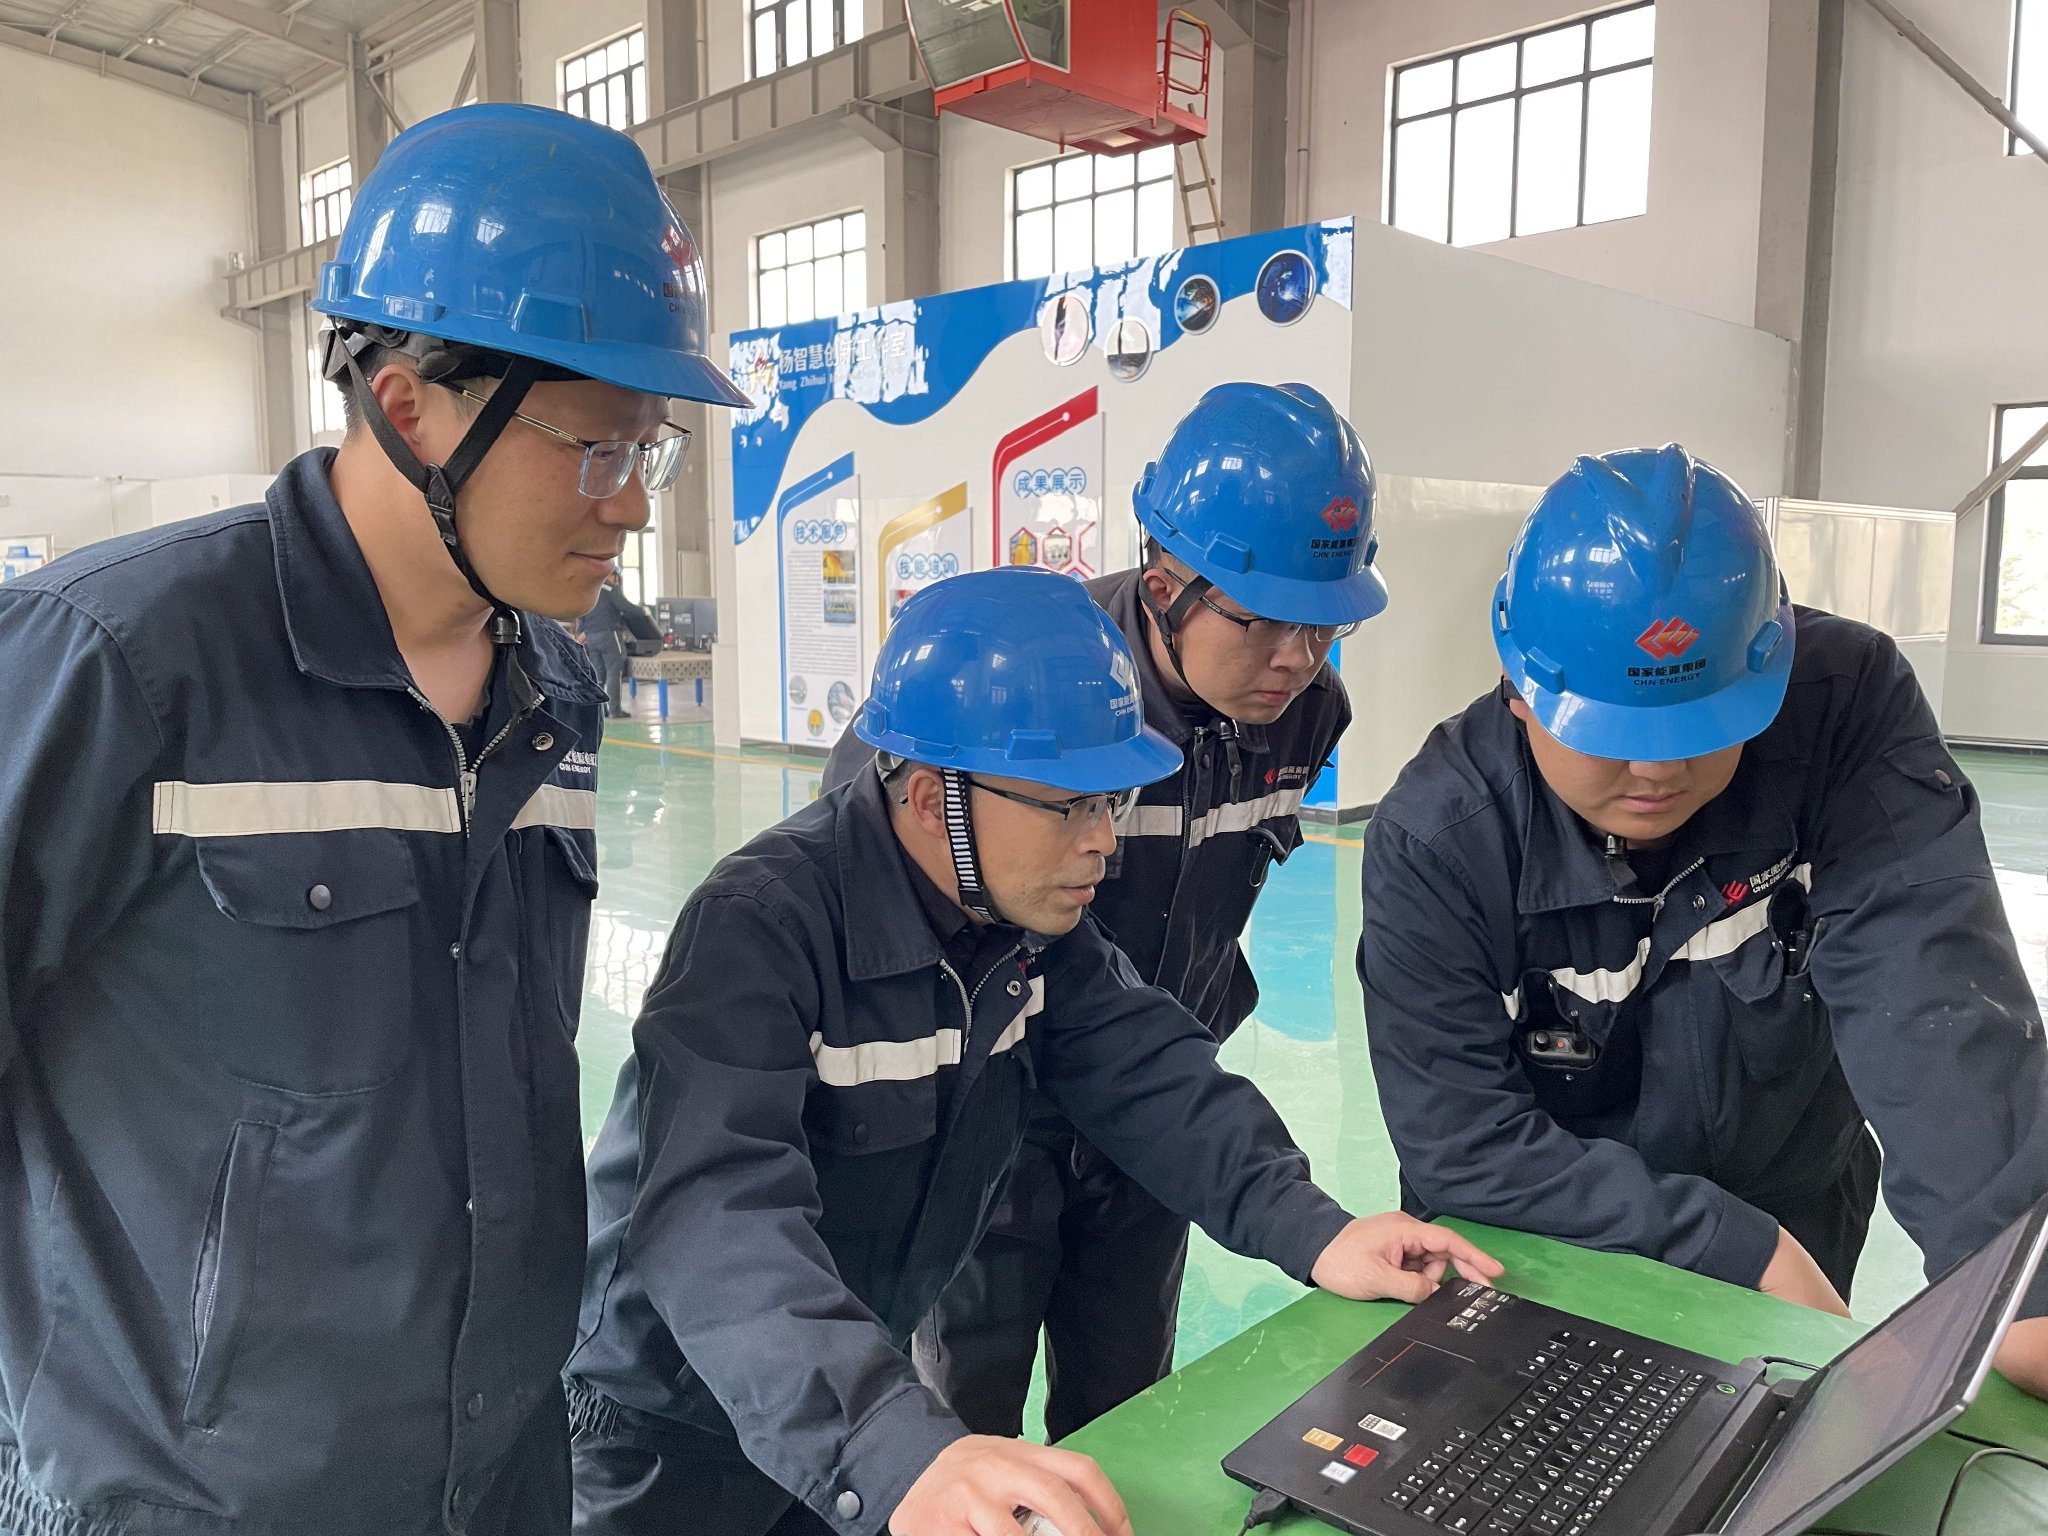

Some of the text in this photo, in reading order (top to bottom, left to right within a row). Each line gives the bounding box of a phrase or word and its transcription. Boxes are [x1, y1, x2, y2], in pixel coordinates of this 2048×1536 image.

[1017, 472, 1084, 494] 成果展示
[899, 557, 956, 576] 技能培训
[1628, 658, 1706, 677] 国家能源集团
[1660, 672, 1701, 685] ENERGY
